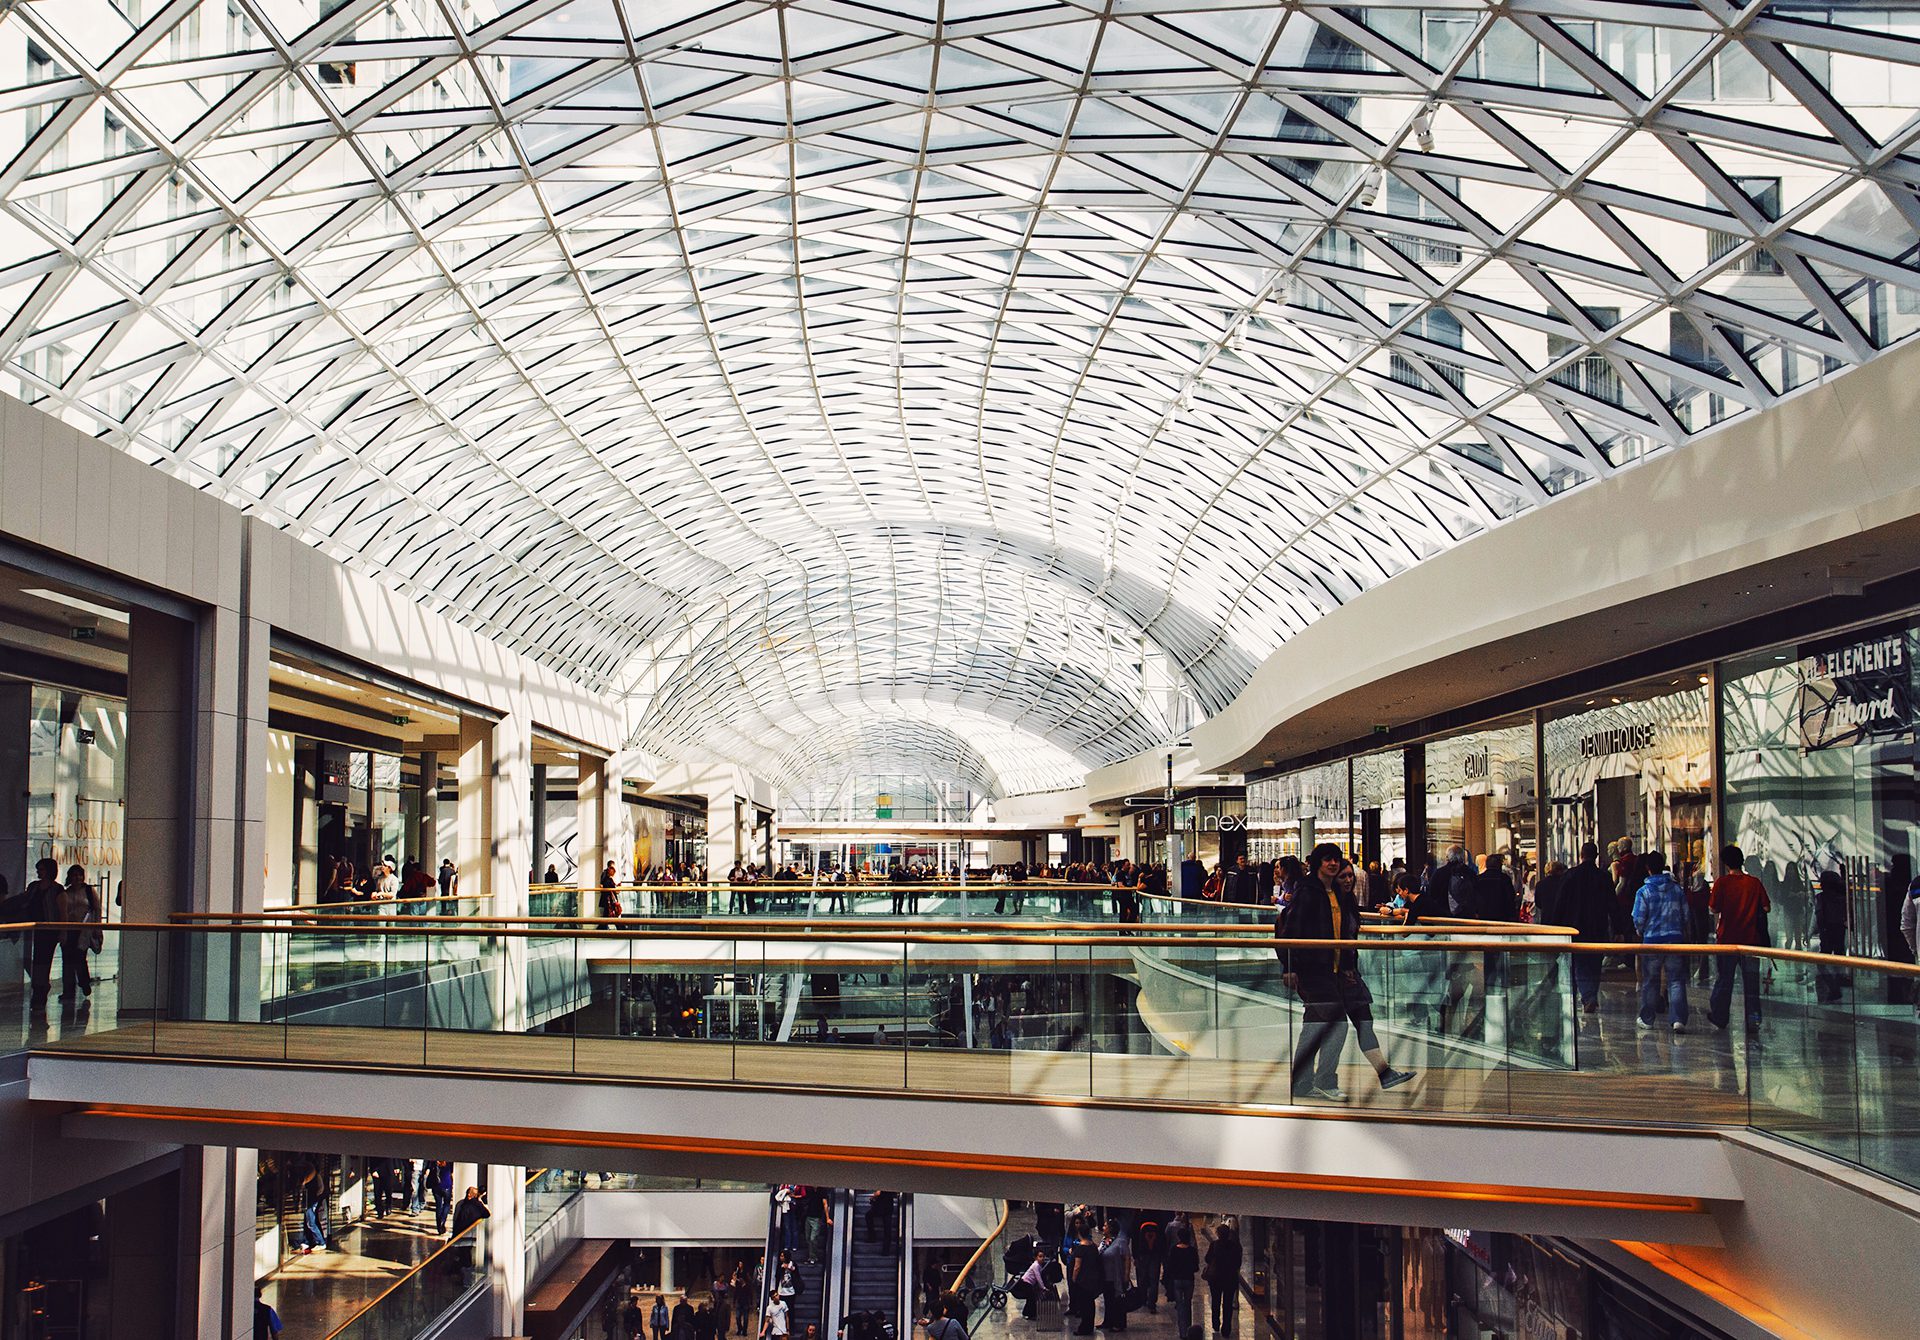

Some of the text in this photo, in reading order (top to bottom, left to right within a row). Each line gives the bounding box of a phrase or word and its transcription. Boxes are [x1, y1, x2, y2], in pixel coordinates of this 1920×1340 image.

[1827, 638, 1902, 679] ELEMENTS
[1580, 722, 1655, 759] DENIM HOUSE
[41, 842, 121, 866] COMING SOON
